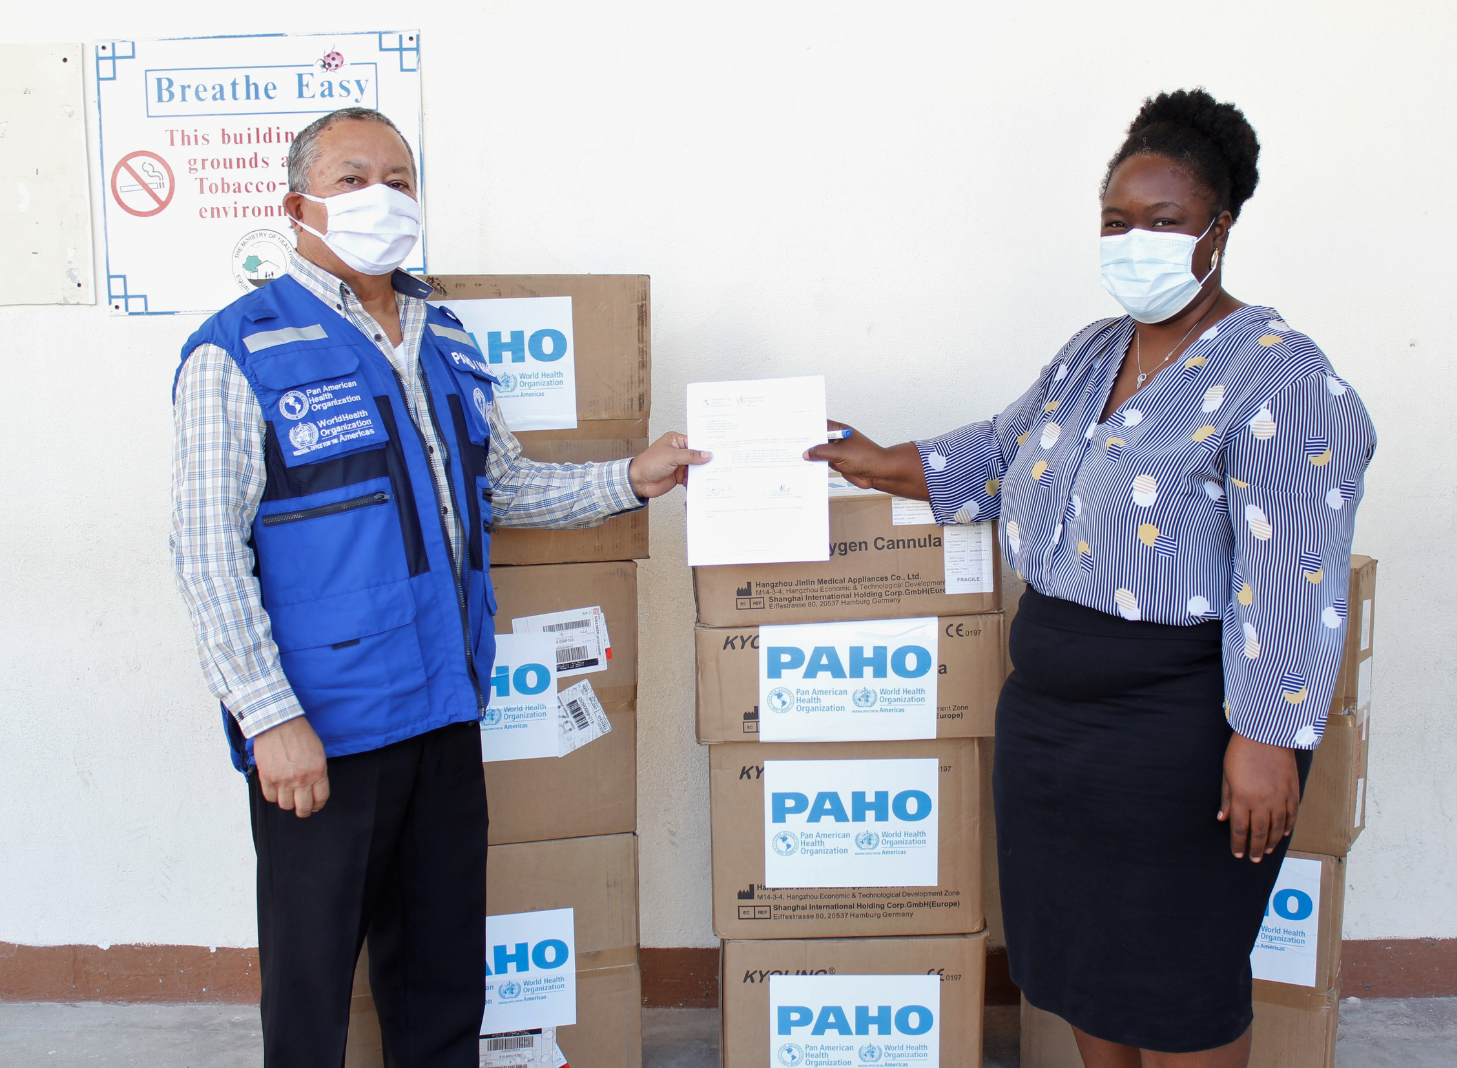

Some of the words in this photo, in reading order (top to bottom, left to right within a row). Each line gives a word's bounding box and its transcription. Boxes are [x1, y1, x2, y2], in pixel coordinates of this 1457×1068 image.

[155, 75, 277, 103] Breathe
[296, 73, 369, 103] Easy
[165, 129, 210, 146] This
[188, 152, 270, 174] grounds
[194, 177, 287, 195] Tobacco-
[519, 371, 539, 380] World
[541, 370, 564, 379] Health
[306, 387, 321, 397] Pan
[322, 380, 358, 393] American
[519, 379, 564, 389] Organization
[308, 392, 333, 405] Health
[311, 394, 361, 412] Organization
[320, 418, 372, 437] Organization
[339, 429, 375, 443] Americas
[873, 533, 942, 551] Cannula
[755, 580, 793, 589] Hangzhou
[795, 579, 815, 587] Jinlin
[817, 577, 846, 586] Medical
[848, 575, 889, 585] Appliances
[786, 586, 818, 595] Hangzhou
[820, 585, 851, 593] Economic
[860, 582, 903, 591] Technological
[769, 594, 803, 604] Shanghai
[805, 592, 852, 601] International
[854, 590, 883, 599] Holding
[841, 598, 871, 606] Hamburg
[872, 597, 901, 605] Germany
[767, 645, 932, 679] PAHO
[796, 688, 809, 696] Pan
[812, 687, 848, 696] American
[880, 687, 900, 695] World
[902, 687, 926, 695] Health
[796, 696, 821, 704] Health
[880, 696, 926, 705] Organization
[503, 705, 523, 713] World
[525, 703, 547, 712] Health
[796, 704, 846, 714] Organization
[503, 711, 547, 721] Organization
[938, 765, 951, 773] 197
[771, 789, 932, 823] PAHO
[800, 831, 813, 839] Pan
[815, 831, 850, 839] American
[881, 830, 901, 838] World
[904, 830, 926, 838] Health
[800, 839, 825, 847] Health
[881, 838, 926, 847] Organization
[800, 847, 848, 857] Organization
[786, 893, 818, 901] Hangzhou
[858, 891, 900, 899] Technological
[902, 890, 942, 898] Development
[773, 904, 807, 912] Shanghai
[857, 902, 885, 910] Holding
[1260, 925, 1281, 935] World
[1283, 928, 1306, 938] Health
[1260, 932, 1306, 945] Organization
[1260, 943, 1285, 952] Americas
[486, 938, 569, 976] HO
[523, 979, 542, 987] World
[544, 976, 565, 984] Health
[523, 983, 565, 994] Organization
[524, 994, 547, 1002] Americas
[777, 1005, 934, 1036] PAHO
[820, 1043, 854, 1051] American
[906, 1043, 928, 1051] Health
[805, 1051, 829, 1059] Health
[884, 1051, 928, 1060] Organization
[805, 1058, 852, 1068] Organization
